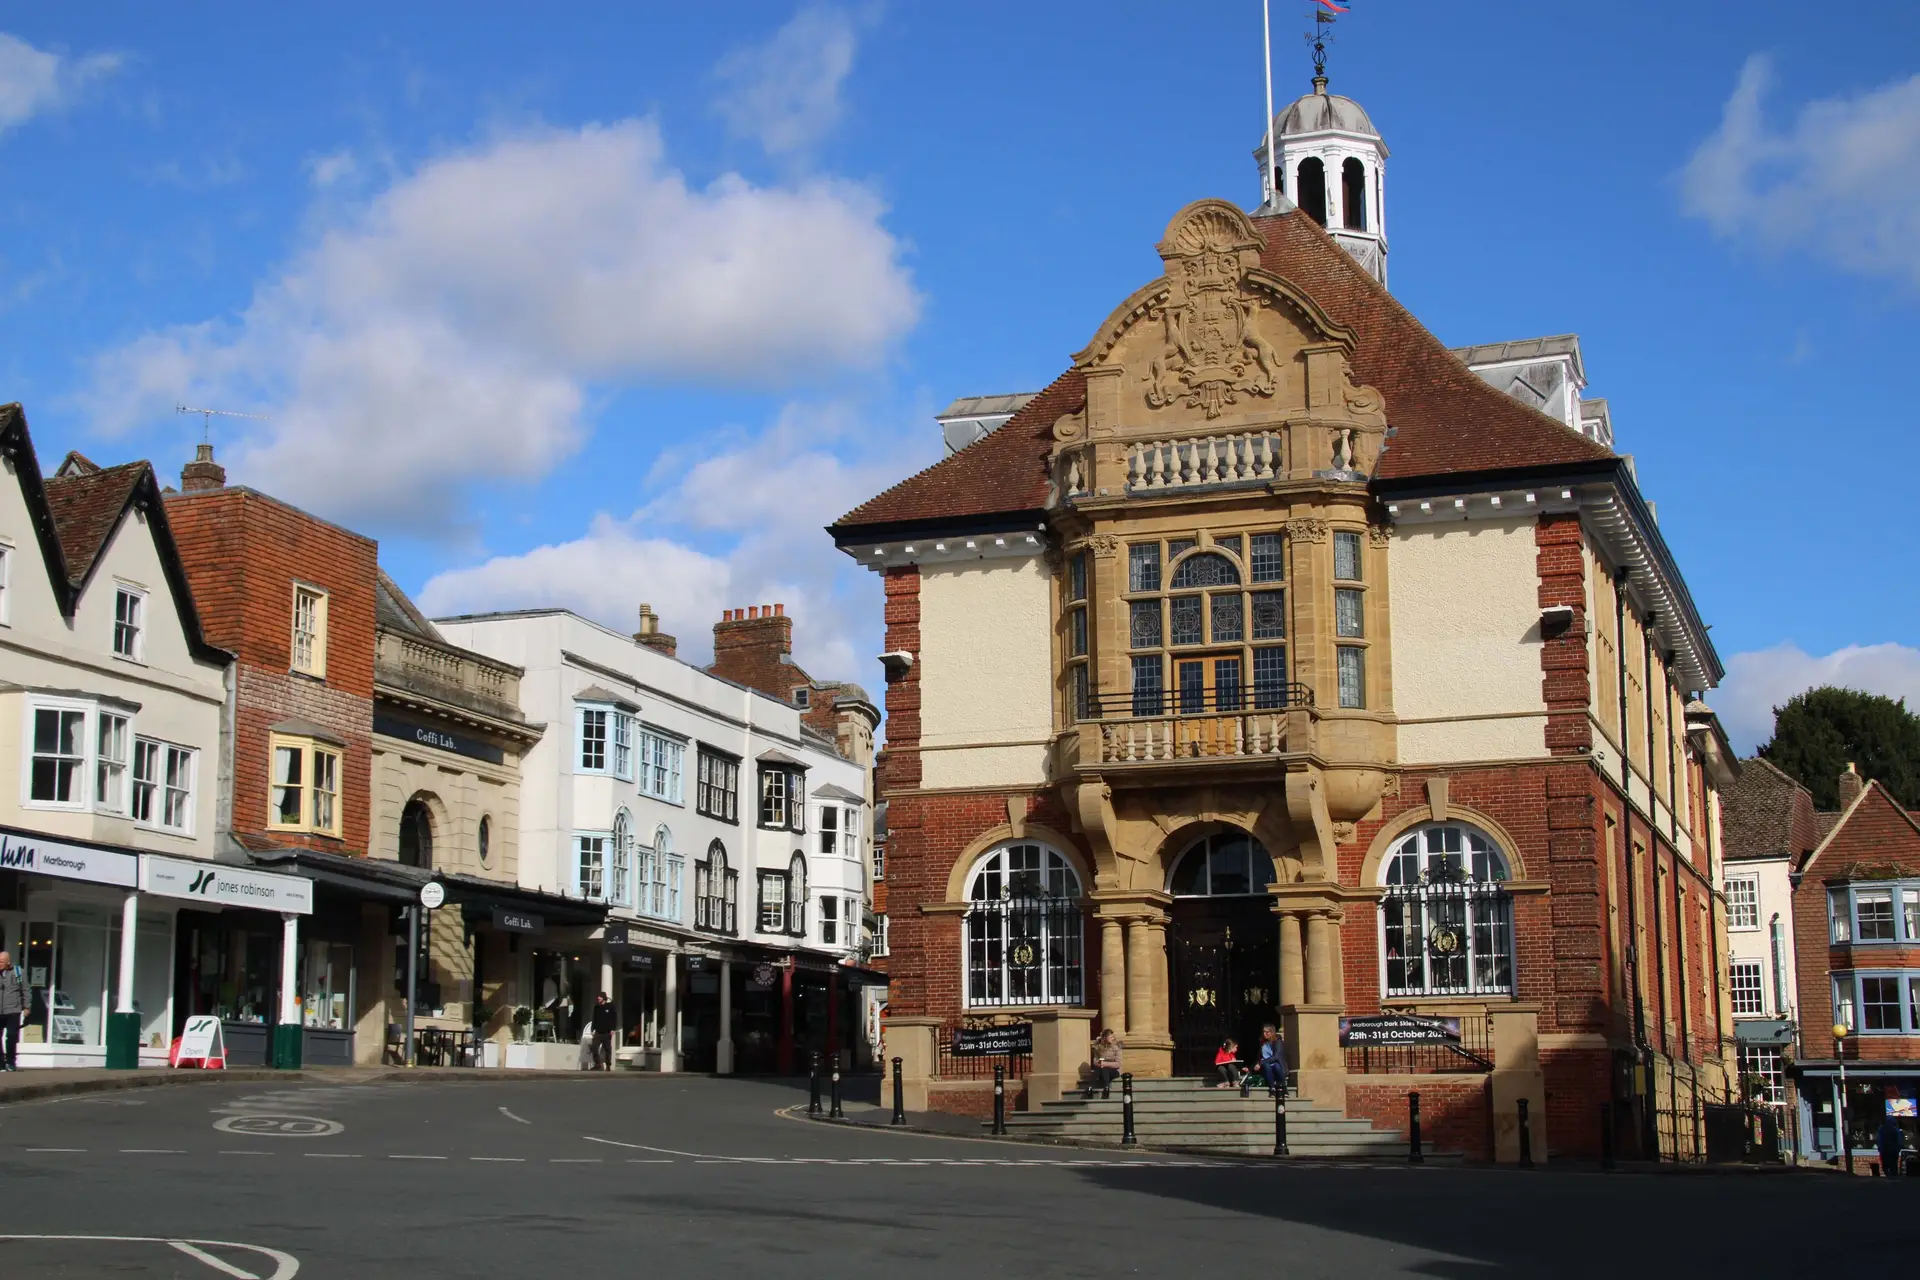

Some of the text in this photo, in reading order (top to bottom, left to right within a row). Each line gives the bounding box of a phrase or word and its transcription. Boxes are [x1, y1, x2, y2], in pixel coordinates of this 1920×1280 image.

[417, 729, 457, 749] Coffi Lab.
[44, 855, 86, 871] Marlborough
[216, 879, 238, 893] jones
[240, 882, 275, 898] robinson
[504, 916, 519, 926] Coffi
[1349, 1032, 1367, 1040] 25th
[1372, 1031, 1389, 1039] 31st
[1390, 1030, 1426, 1039] October
[979, 1041, 992, 1049] 31st
[993, 1039, 1017, 1048] October
[185, 1047, 203, 1056] Open
[230, 1118, 327, 1132] 20
